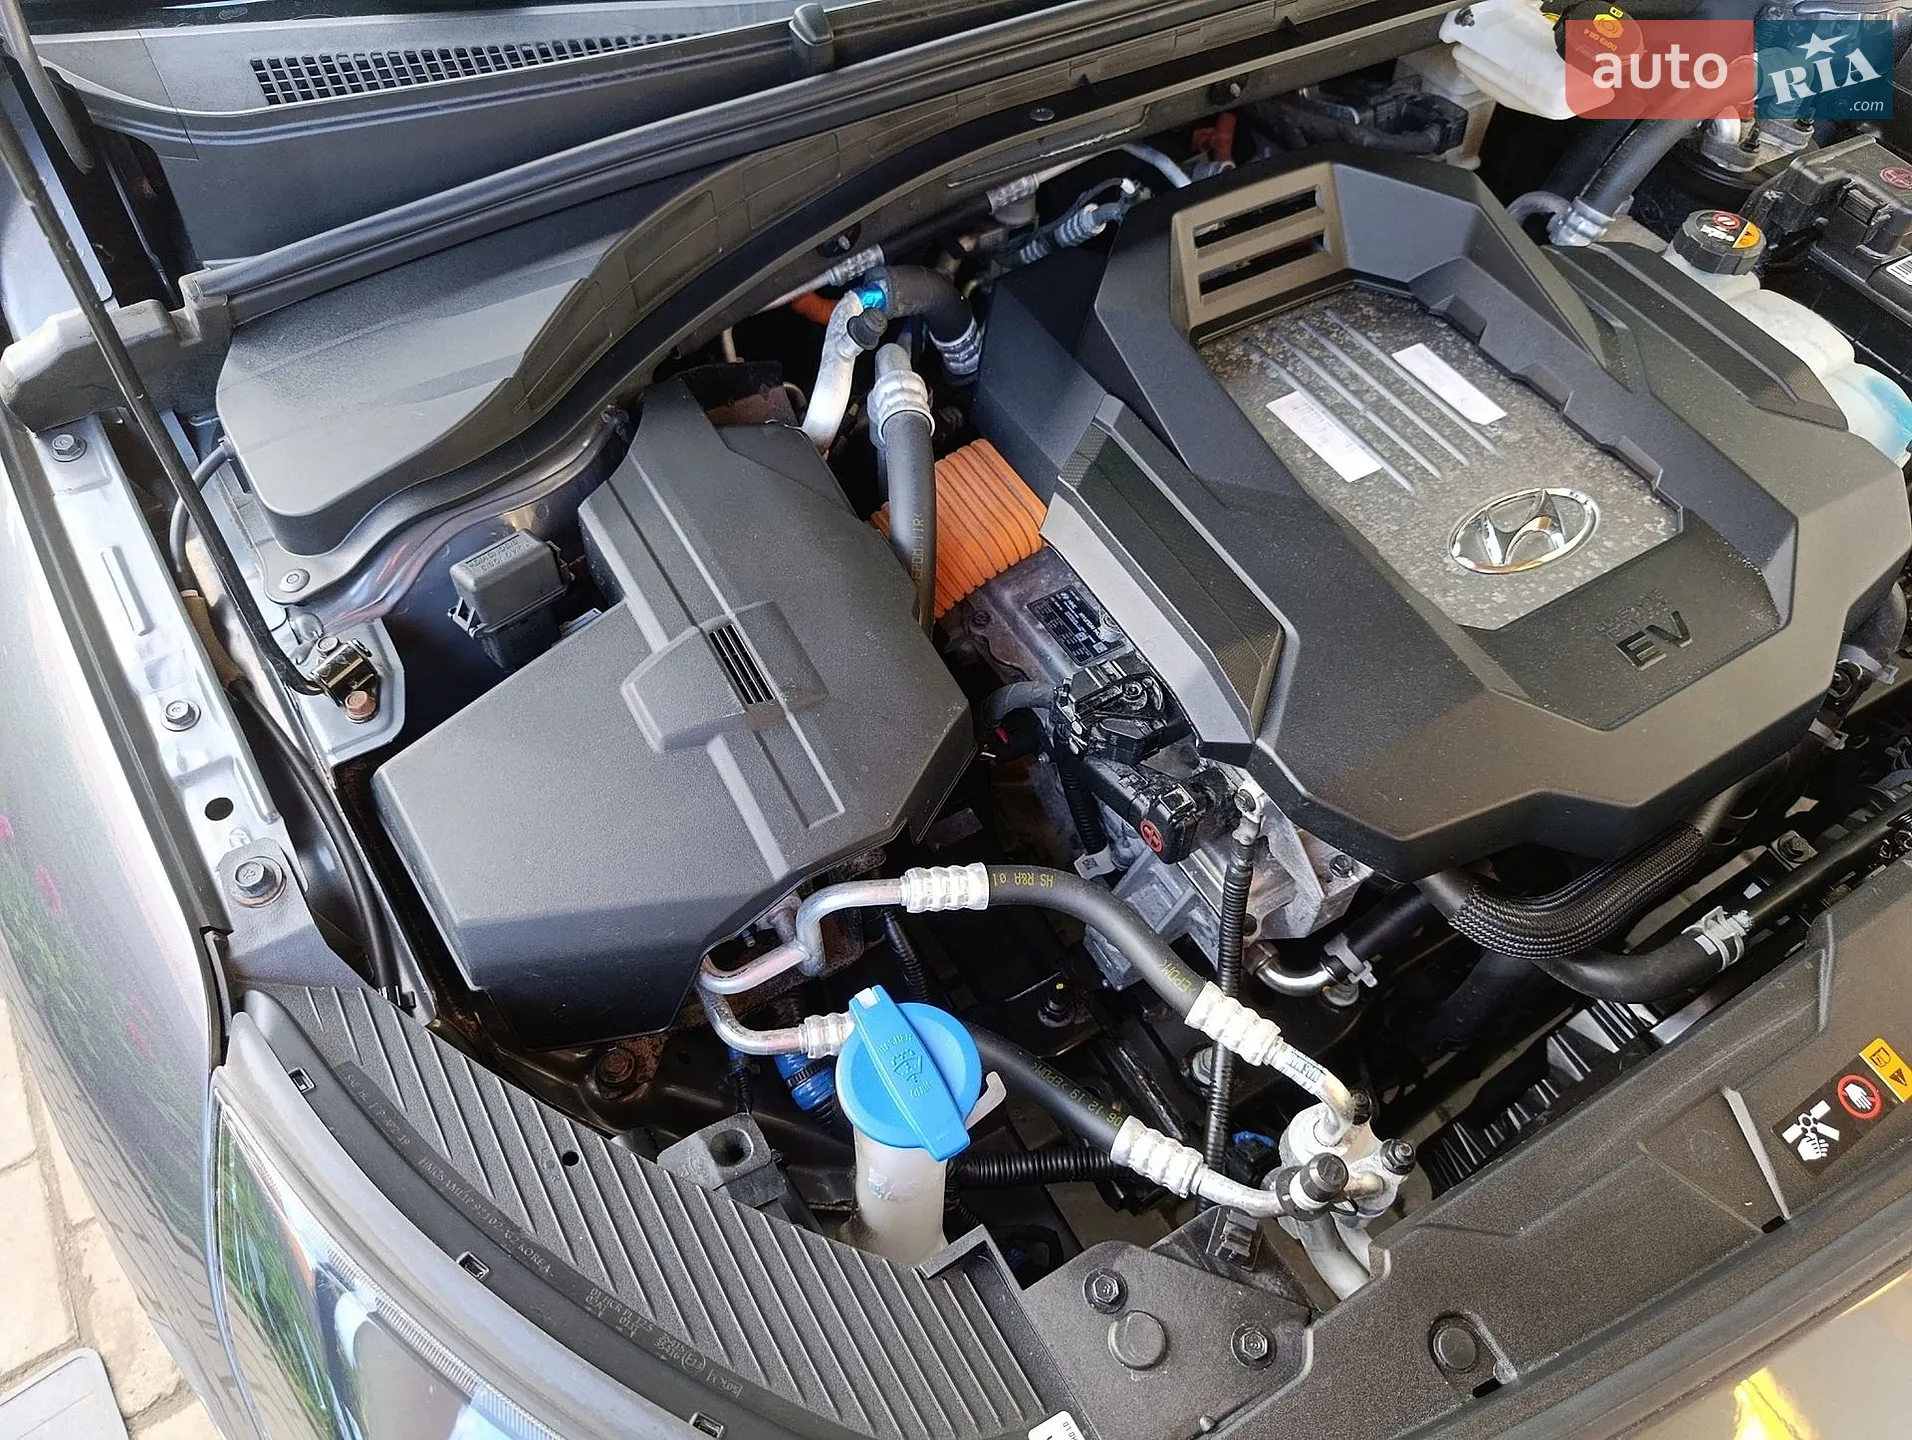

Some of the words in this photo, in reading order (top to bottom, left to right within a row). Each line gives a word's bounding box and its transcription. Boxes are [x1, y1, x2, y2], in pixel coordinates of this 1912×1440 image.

[1614, 610, 1692, 671] EV
[1040, 873, 1054, 888] HS
[1069, 1088, 1085, 1103] 19
[1088, 1101, 1104, 1115] 12
[1106, 1112, 1123, 1127] 06
